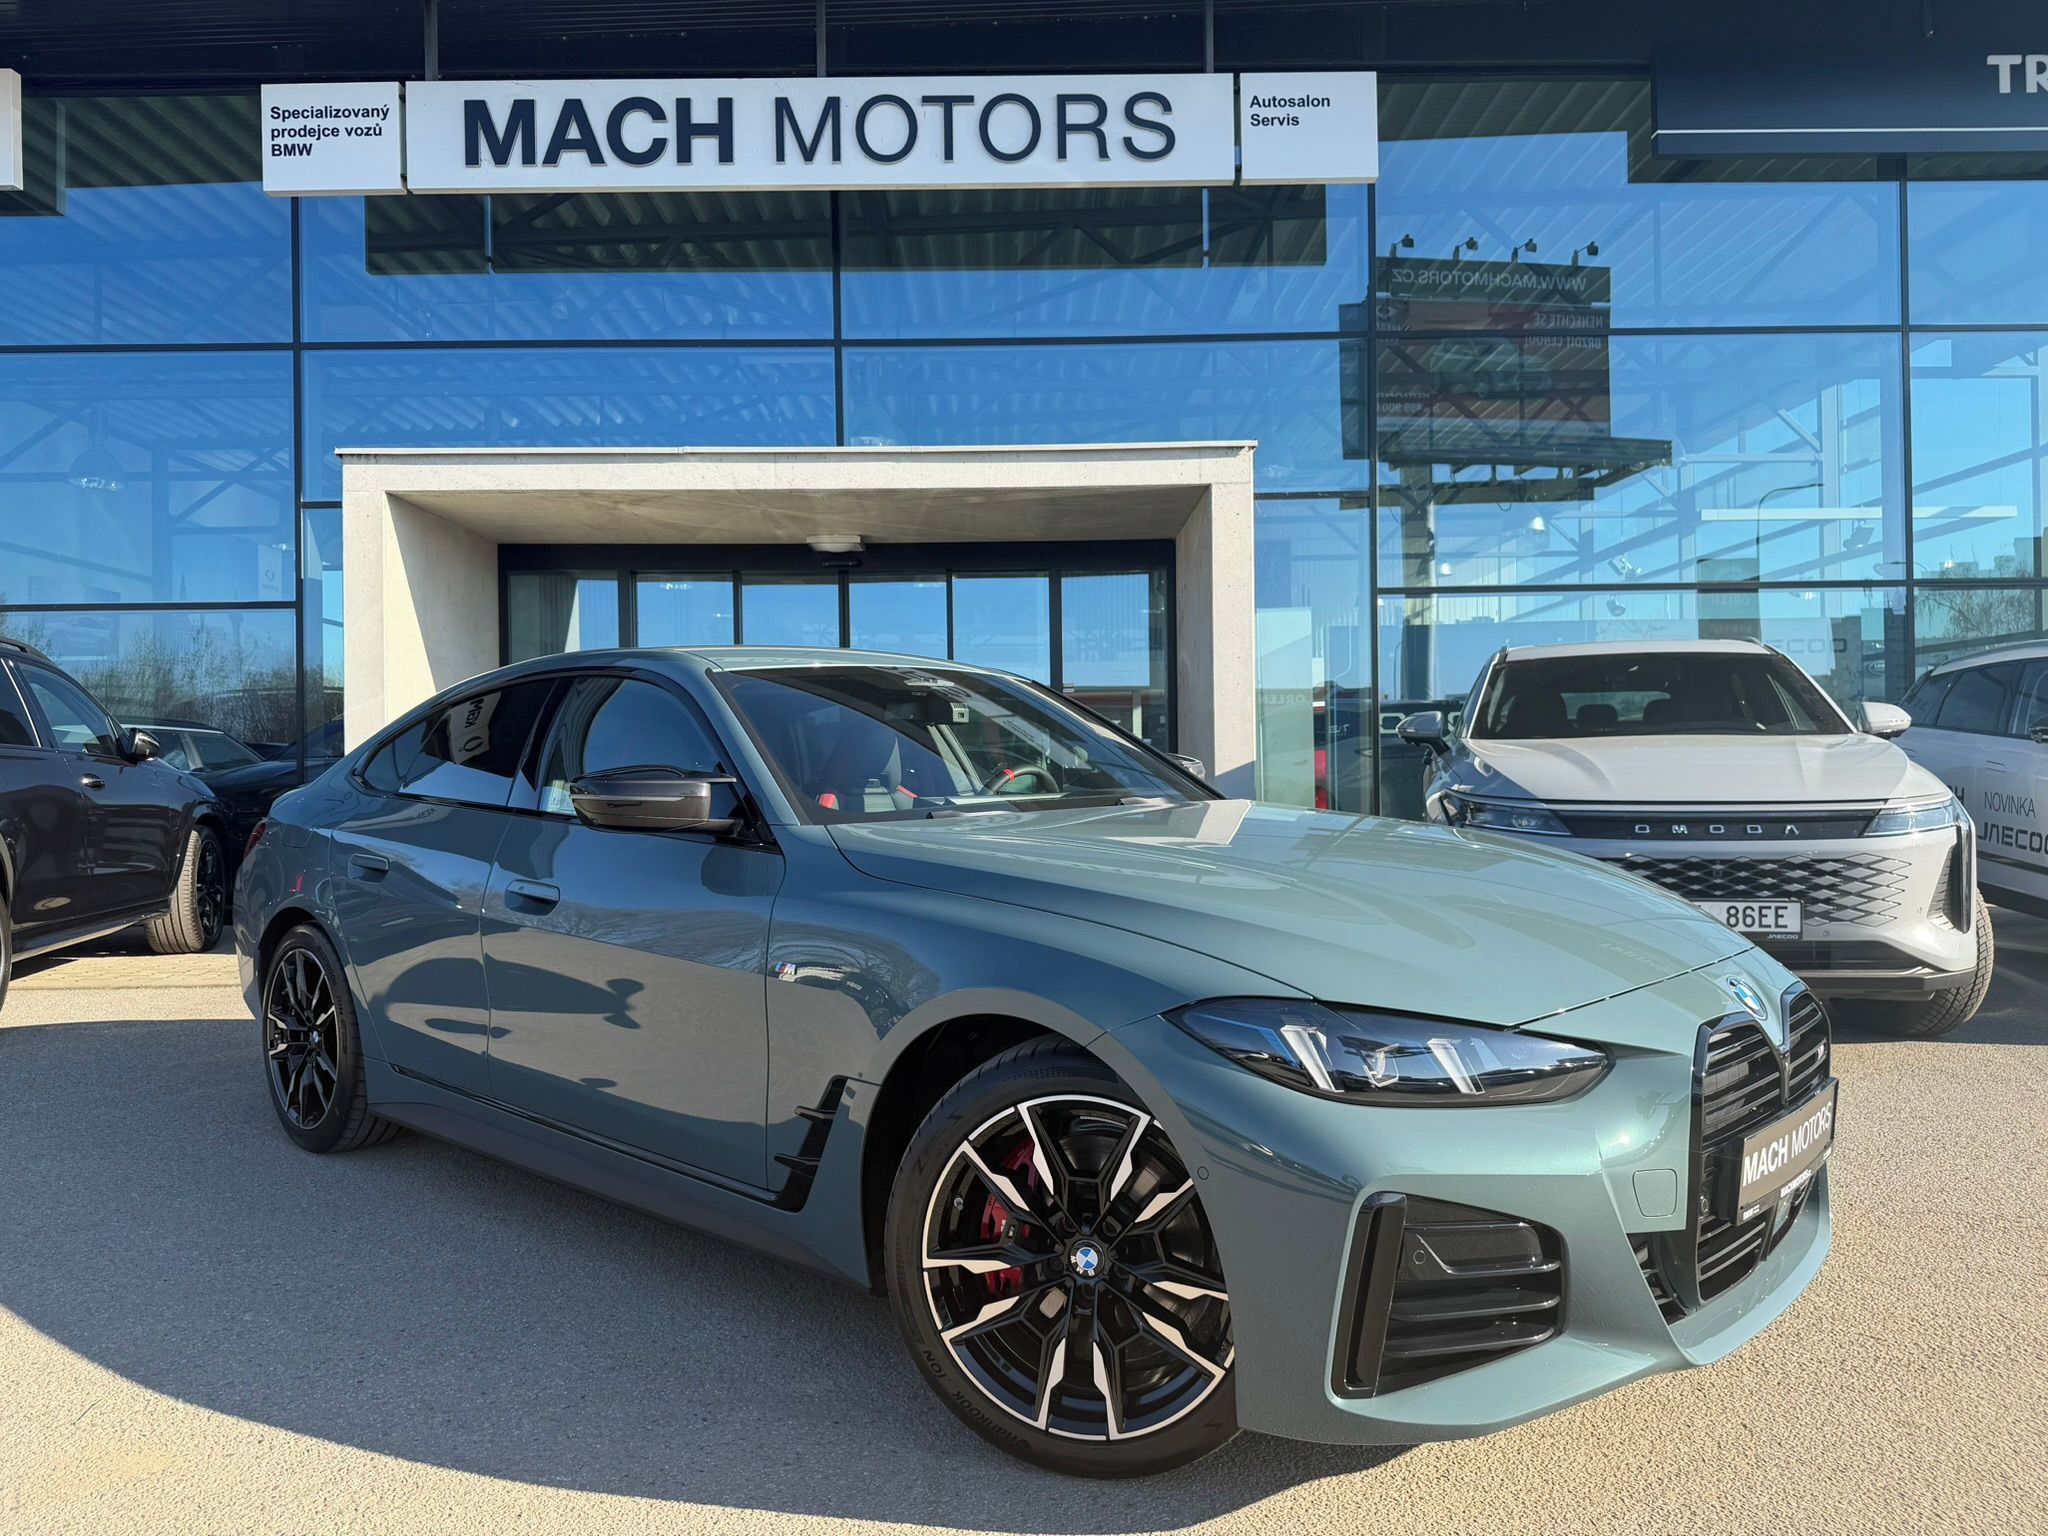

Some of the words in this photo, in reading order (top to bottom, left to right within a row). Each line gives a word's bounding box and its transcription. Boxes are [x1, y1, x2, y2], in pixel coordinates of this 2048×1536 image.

[1249, 94, 1331, 108] Autosalon
[270, 104, 390, 122] Specializovaný
[1250, 113, 1300, 127] Servis
[271, 124, 340, 141] prodejce
[344, 122, 382, 137] vozů
[463, 96, 736, 168] MACH
[774, 90, 1177, 166] MOTORS
[271, 143, 313, 157] BMW
[1984, 791, 2036, 818] NOVINKA
[1635, 824, 1799, 835] OMODA
[1742, 1134, 1789, 1187] MACH
[1791, 1101, 1832, 1158] MOTORS
